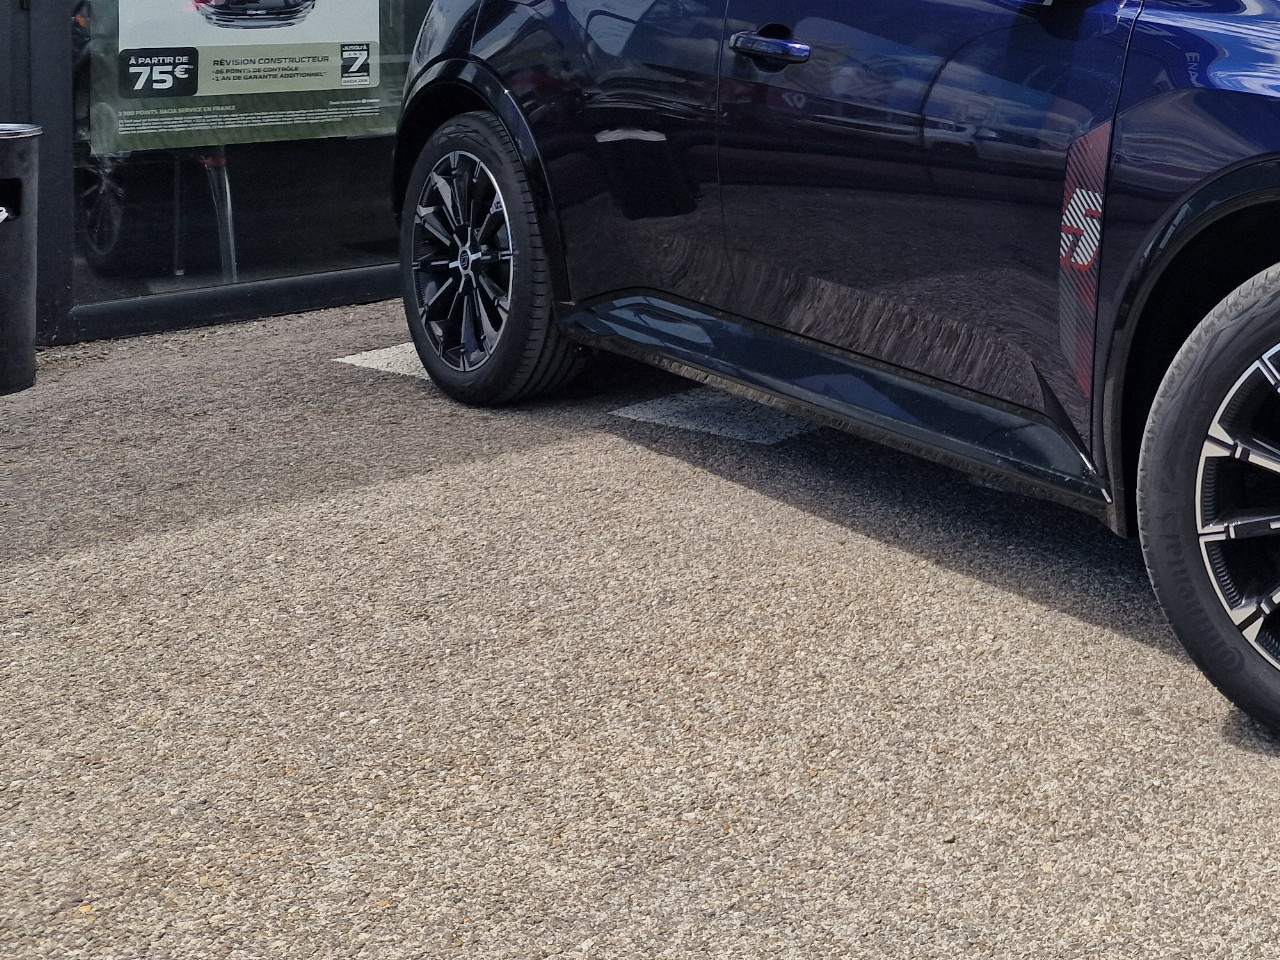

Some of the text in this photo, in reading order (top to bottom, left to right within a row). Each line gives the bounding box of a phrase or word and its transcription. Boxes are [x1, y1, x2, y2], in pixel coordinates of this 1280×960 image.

[129, 56, 136, 64] À
[138, 56, 173, 64] PARTIR
[213, 56, 329, 66] RÉVISION CONSTRUCTEUR
[342, 51, 368, 72] 7
